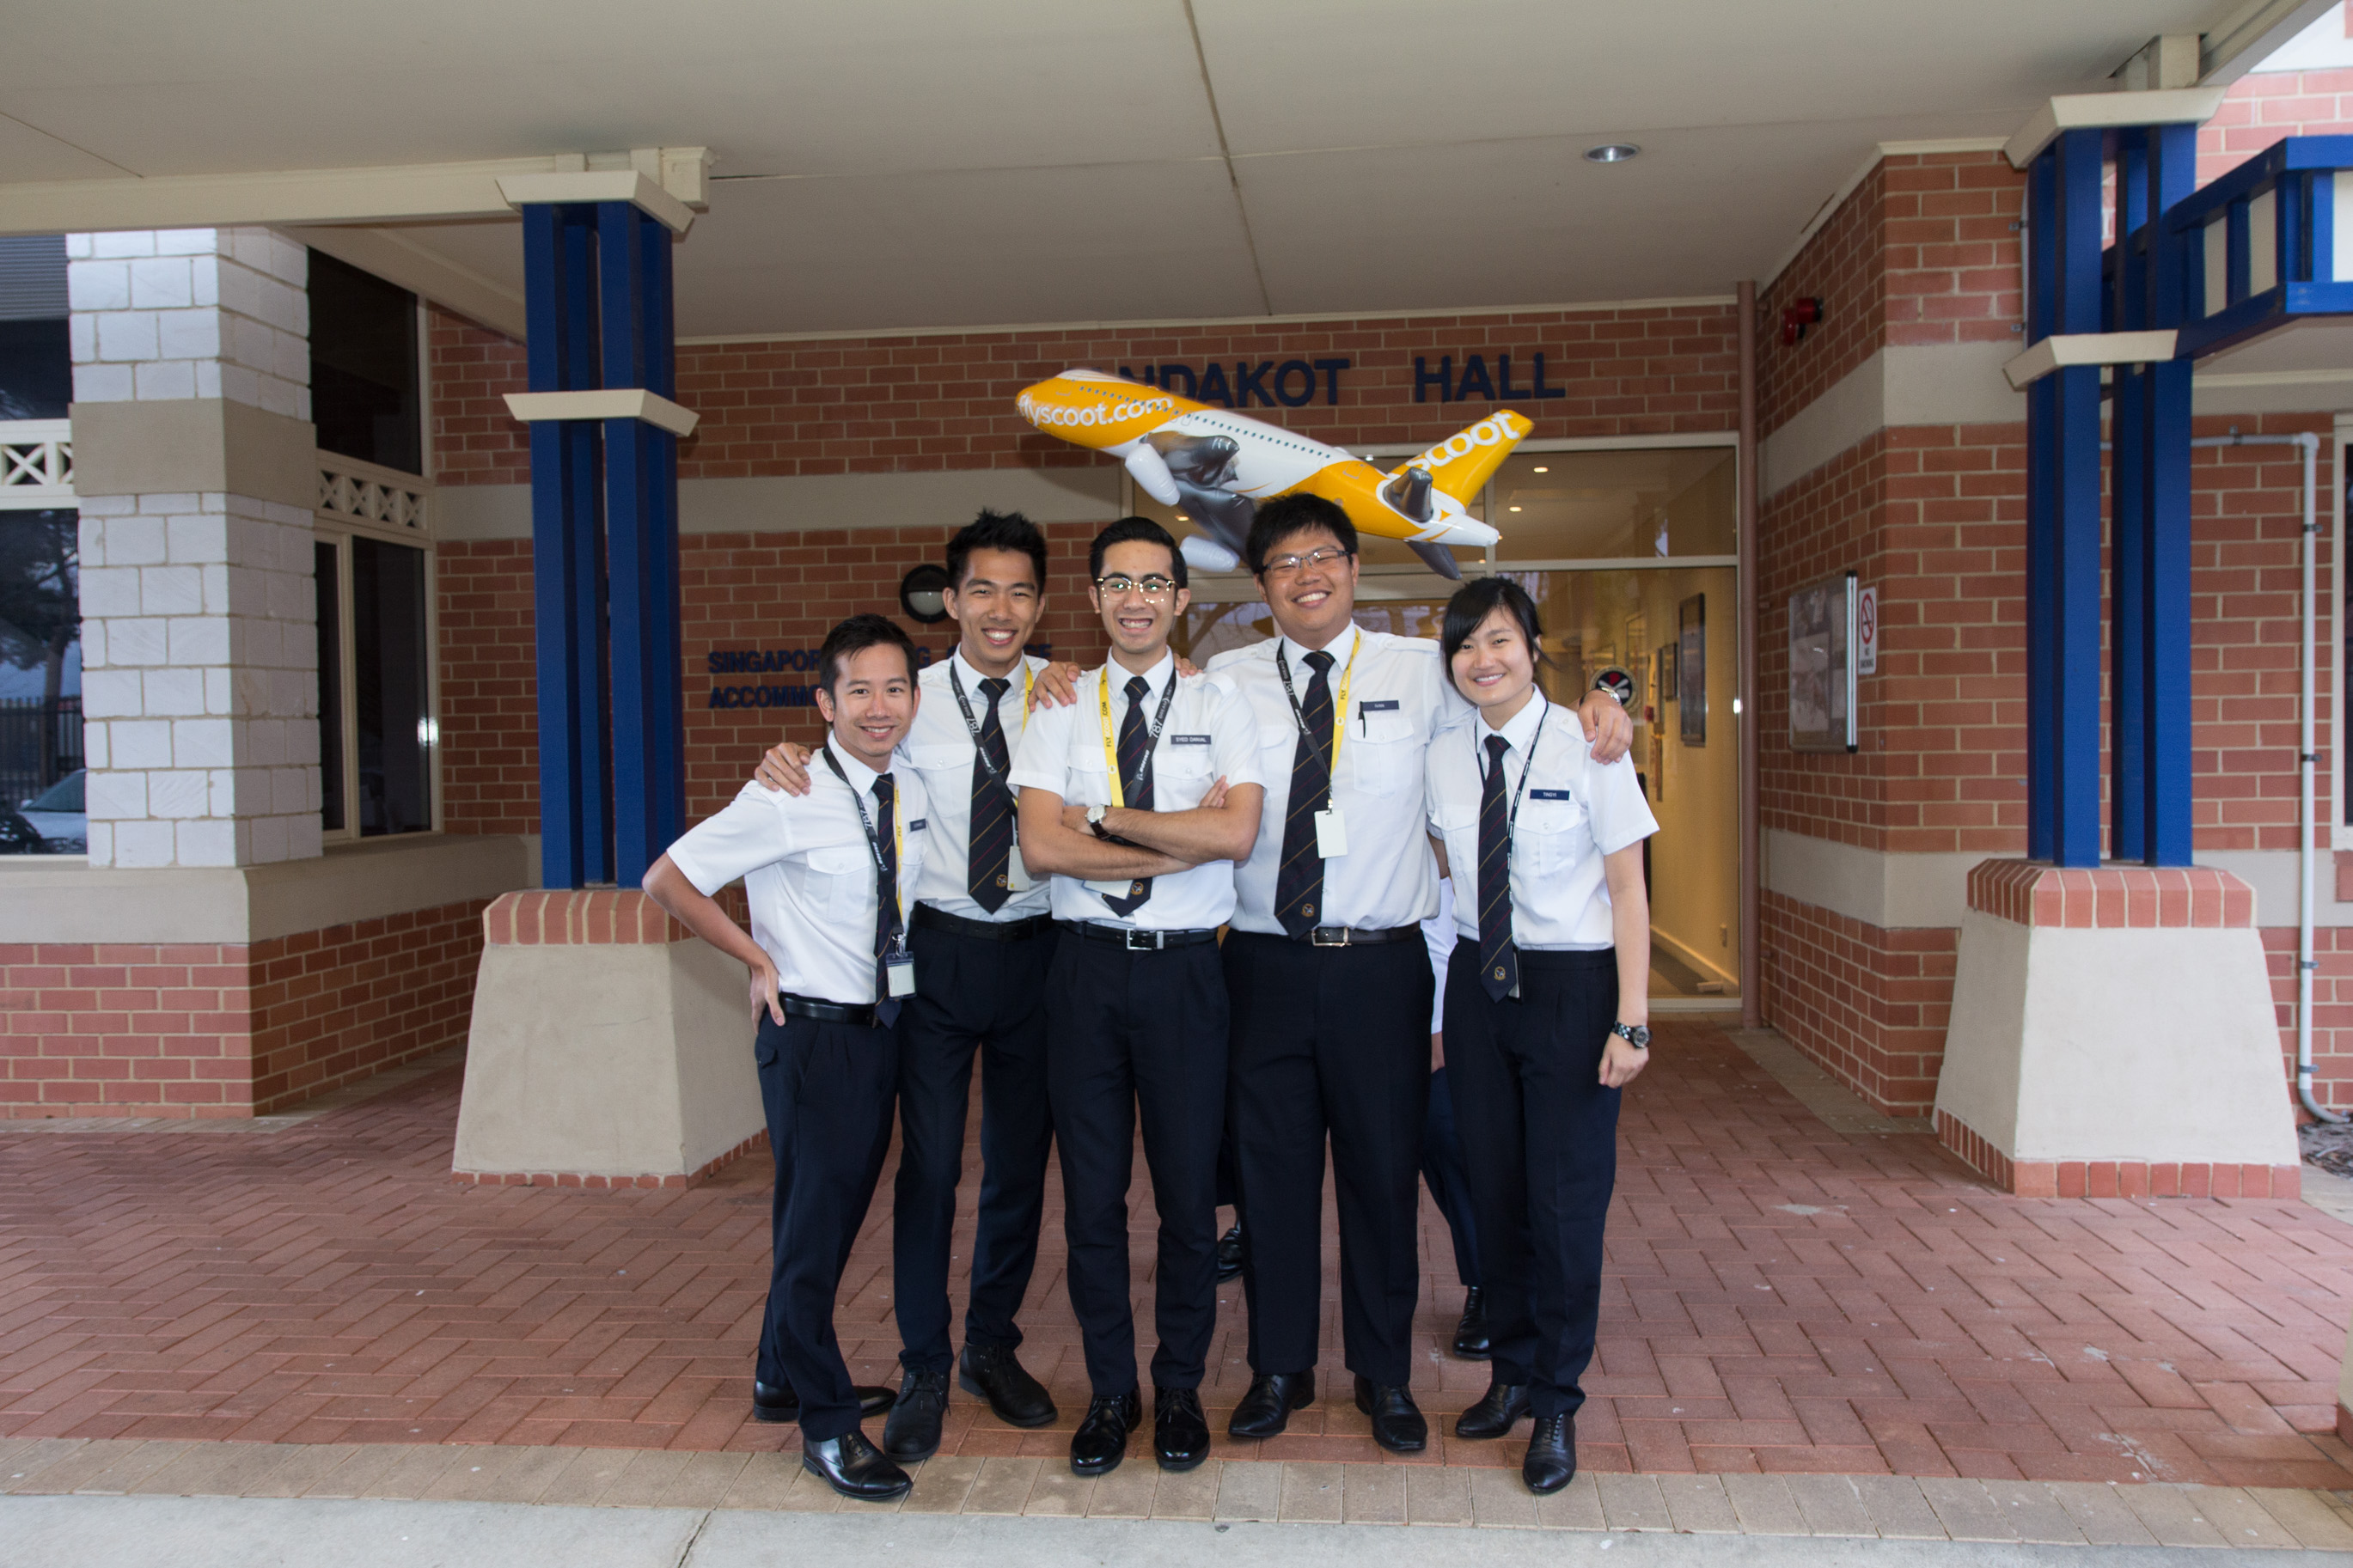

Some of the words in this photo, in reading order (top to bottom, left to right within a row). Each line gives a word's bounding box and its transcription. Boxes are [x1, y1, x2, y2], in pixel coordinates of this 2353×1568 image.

[1415, 352, 1566, 403] HALL
[1018, 392, 1173, 427] flyscoot.com
[1405, 412, 1520, 472] scoot
[708, 650, 821, 674] SINGAPOR
[708, 684, 819, 709] ACCOMMO
[966, 717, 981, 737] 787
[1149, 718, 1163, 738] 787
[859, 808, 872, 831] 787
